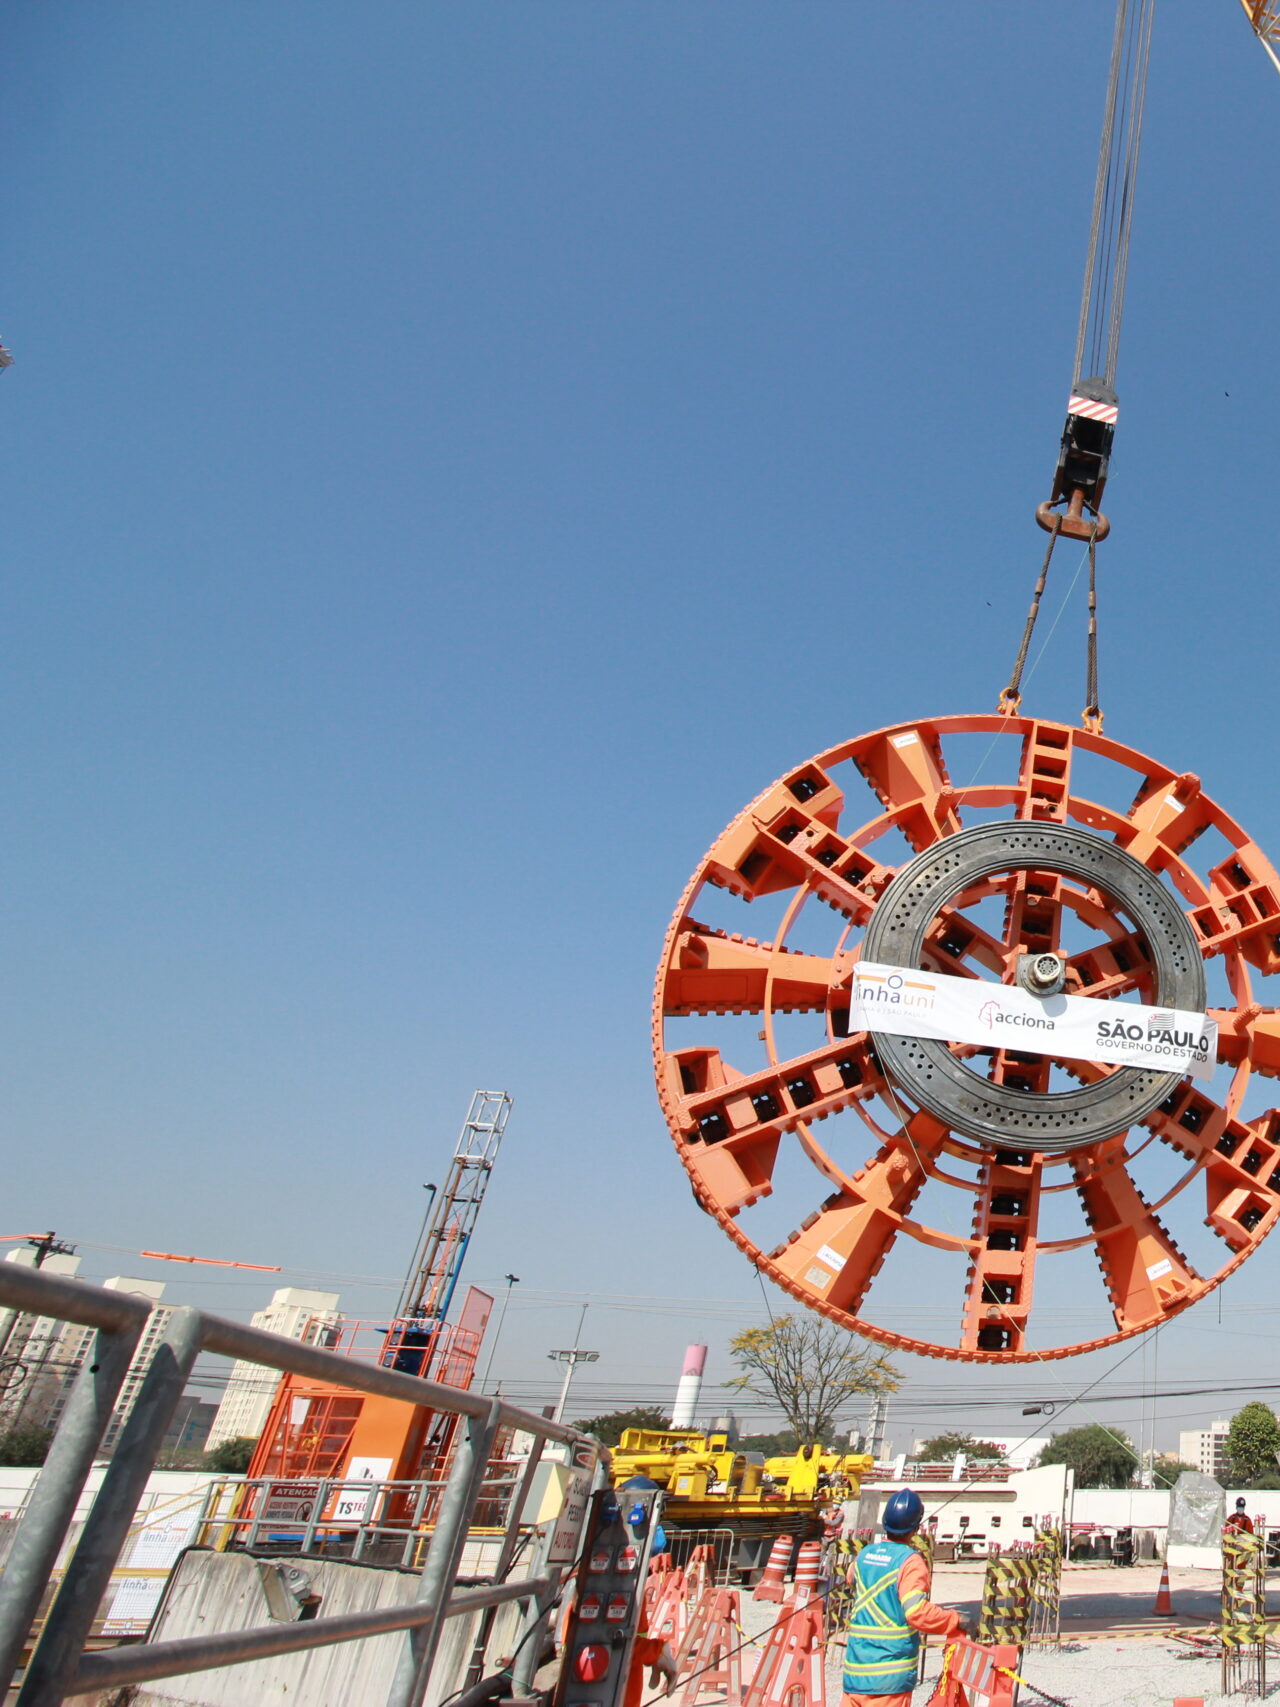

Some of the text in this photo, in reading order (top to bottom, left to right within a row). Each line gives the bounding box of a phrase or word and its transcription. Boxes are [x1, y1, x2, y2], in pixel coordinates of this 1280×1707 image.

[995, 1012, 1055, 1031] acciona
[1097, 1018, 1209, 1053] SÃO PAULO
[1096, 1038, 1153, 1052] GOVERNO
[1154, 1044, 1171, 1055] DO
[1173, 1048, 1208, 1063] ESTADO
